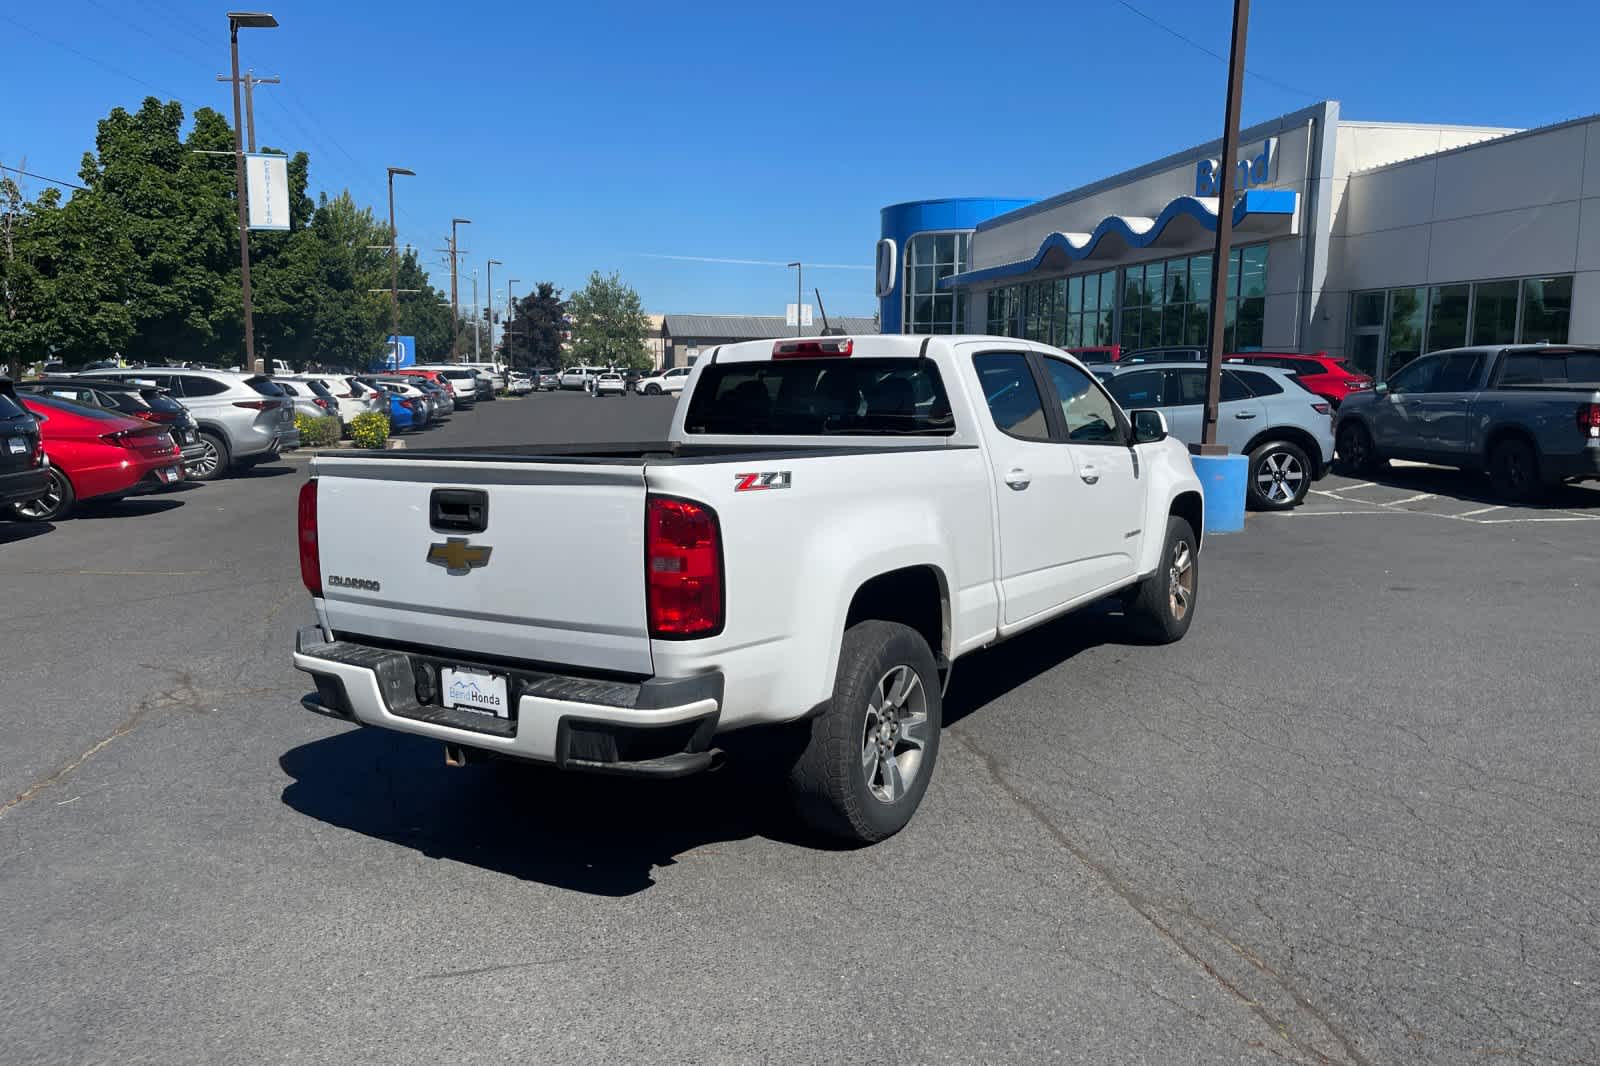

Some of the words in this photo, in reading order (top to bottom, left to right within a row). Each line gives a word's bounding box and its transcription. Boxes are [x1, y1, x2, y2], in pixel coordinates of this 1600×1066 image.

[1196, 137, 1271, 197] Bnd
[734, 471, 792, 492] Z71
[328, 575, 380, 592] COLORADO
